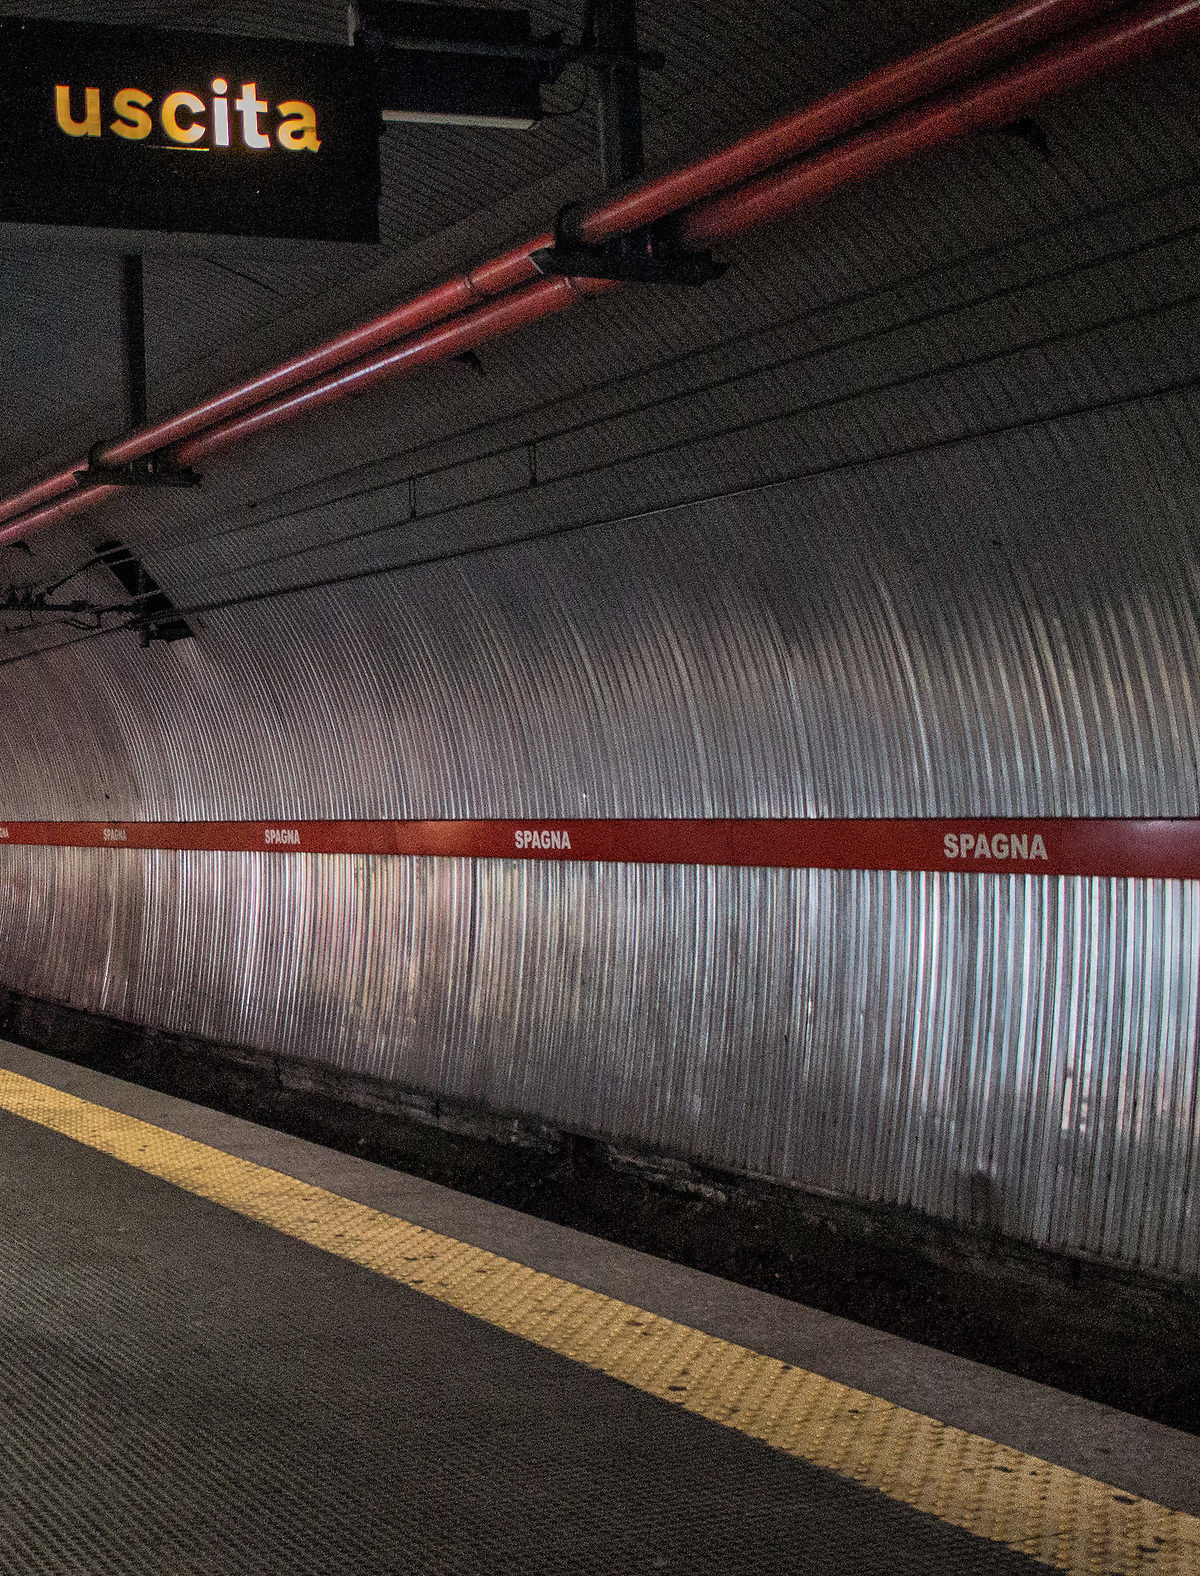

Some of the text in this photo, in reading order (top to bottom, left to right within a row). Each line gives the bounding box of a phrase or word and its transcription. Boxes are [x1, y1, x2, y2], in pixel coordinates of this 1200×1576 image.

[54, 77, 322, 152] uscita
[264, 829, 301, 845] SPAGNA
[514, 830, 571, 850] SPAGNA
[943, 833, 1049, 860] SPAGNA
